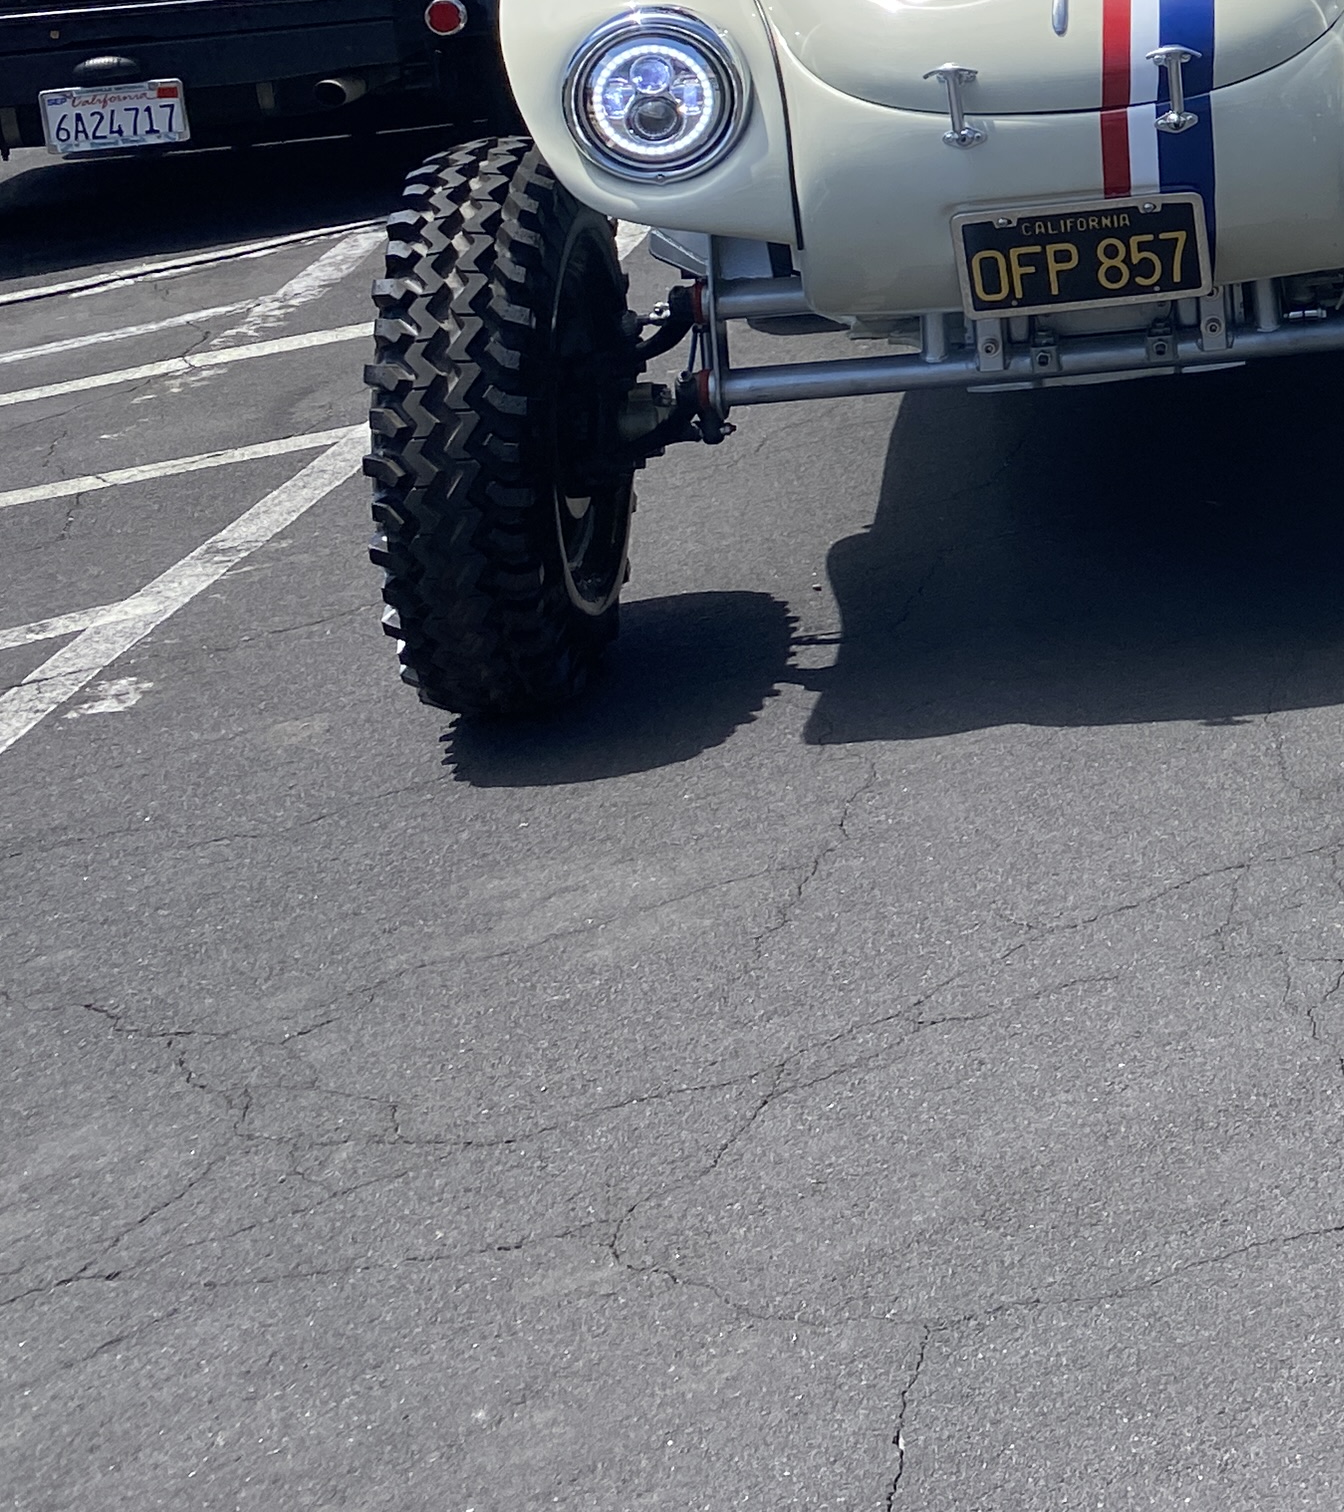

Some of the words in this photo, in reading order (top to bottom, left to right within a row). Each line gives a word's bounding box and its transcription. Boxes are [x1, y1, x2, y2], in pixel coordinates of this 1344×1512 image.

[55, 103, 175, 143] 6A24717
[1021, 213, 1131, 236] CALIFORNIA
[971, 243, 1079, 302] OFP
[1096, 231, 1187, 290] 857
